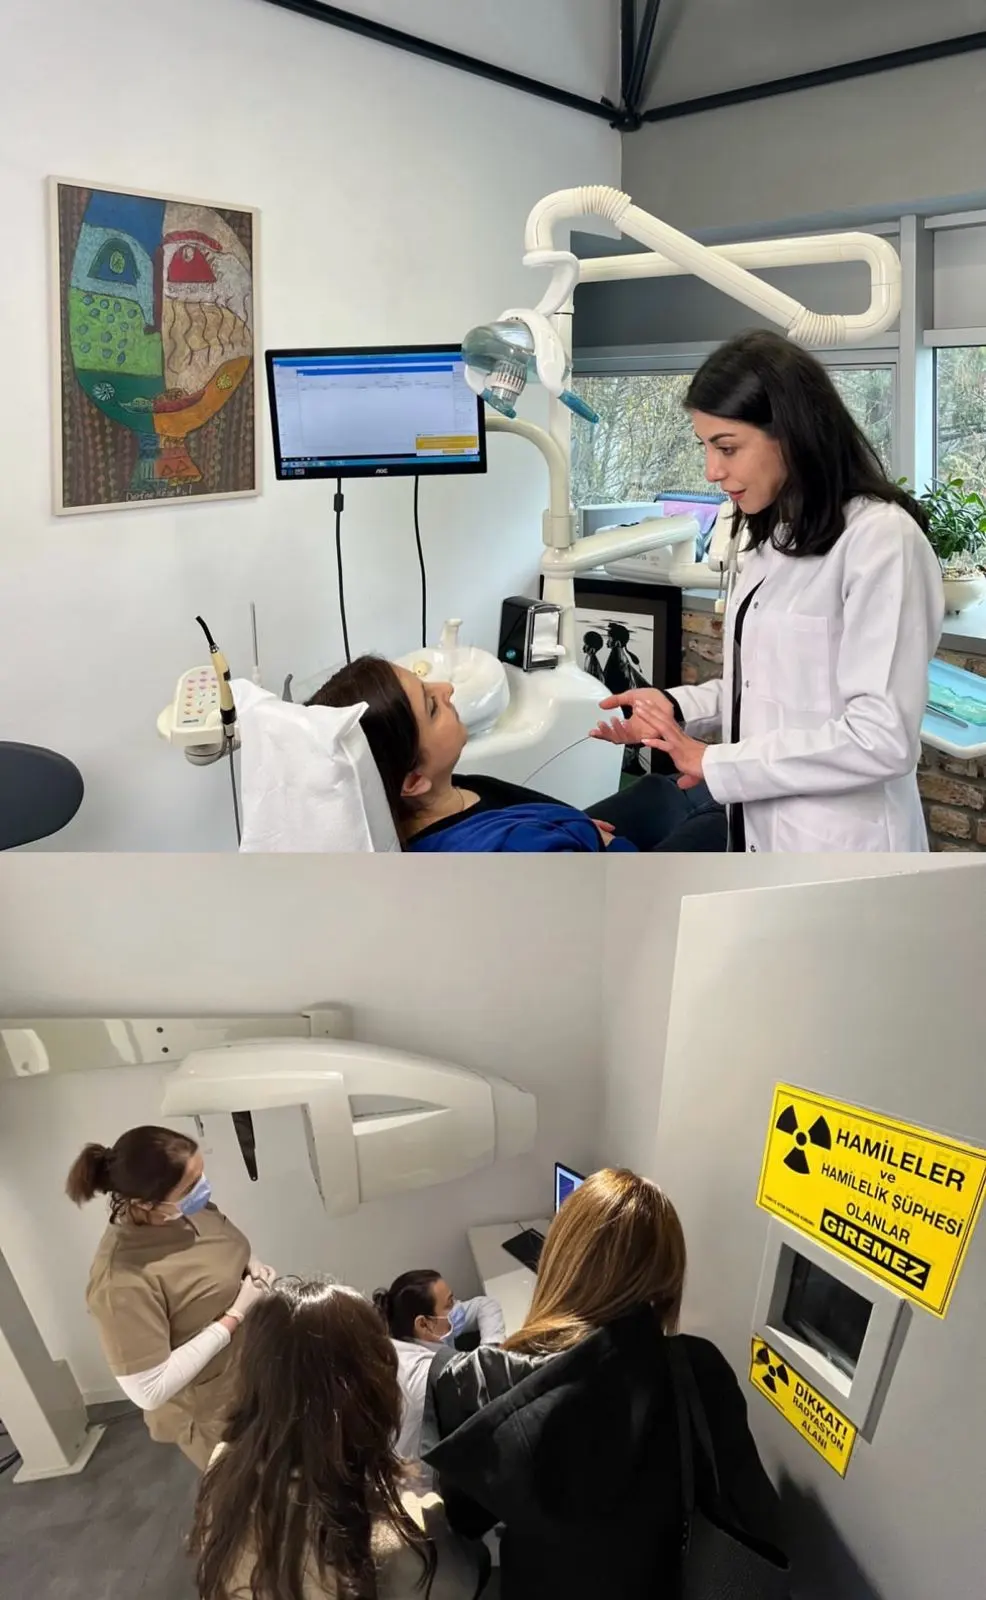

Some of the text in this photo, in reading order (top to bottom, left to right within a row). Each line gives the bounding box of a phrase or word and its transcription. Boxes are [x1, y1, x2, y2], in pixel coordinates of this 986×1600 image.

[835, 1128, 966, 1192] HAMİLELER
[880, 1169, 896, 1184] ve
[821, 1162, 964, 1238] HAMİLELİK ŞÜPHESİ
[846, 1202, 910, 1245] OLANLAR
[823, 1214, 926, 1284] GİREMEZ
[792, 1396, 844, 1451] RADYASYON
[795, 1382, 848, 1439] DİKKAT!
[802, 1421, 827, 1449] ALANI
